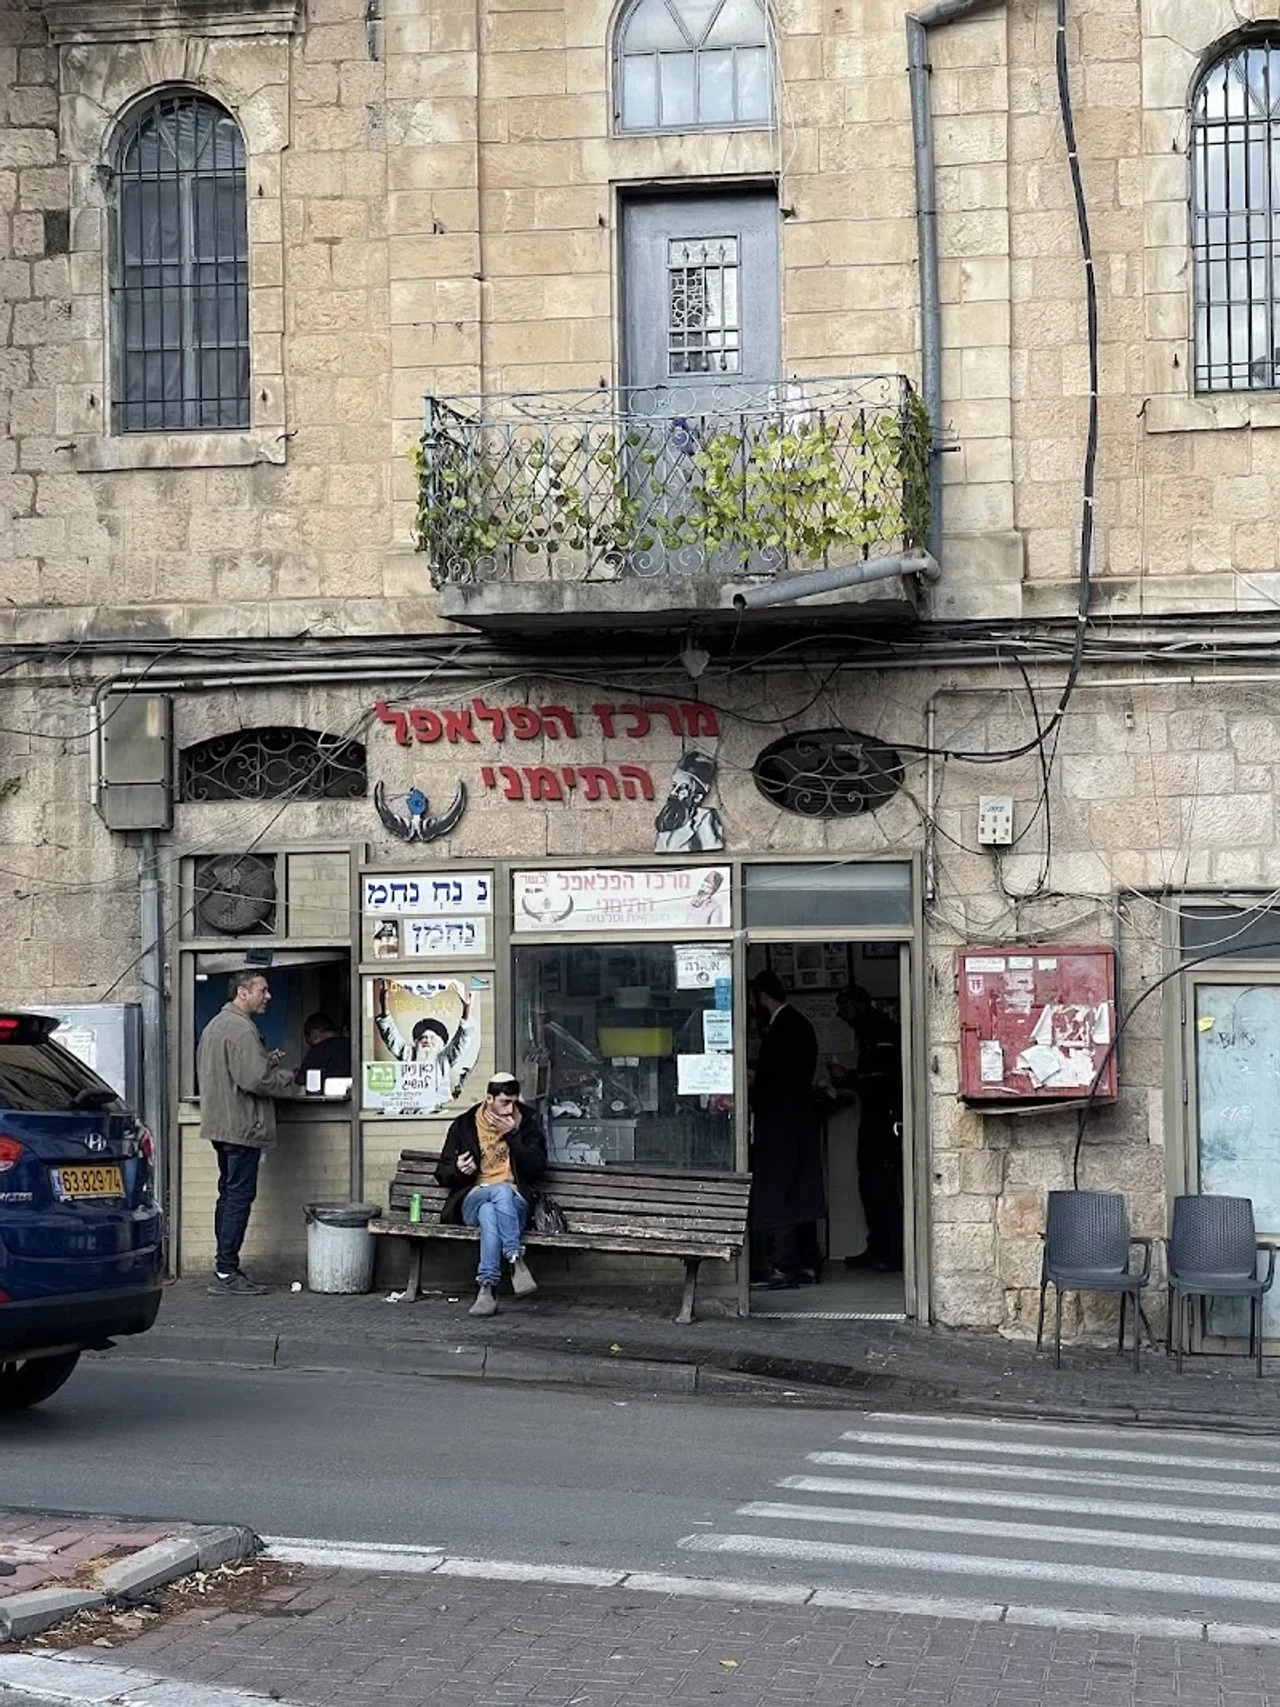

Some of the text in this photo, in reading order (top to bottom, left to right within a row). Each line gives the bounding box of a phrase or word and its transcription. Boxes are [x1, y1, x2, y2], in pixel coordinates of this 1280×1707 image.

[374, 699, 720, 746] מרכז הפלאפל
[480, 765, 655, 800] התימני
[557, 873, 691, 891] מרכז הפלאפל
